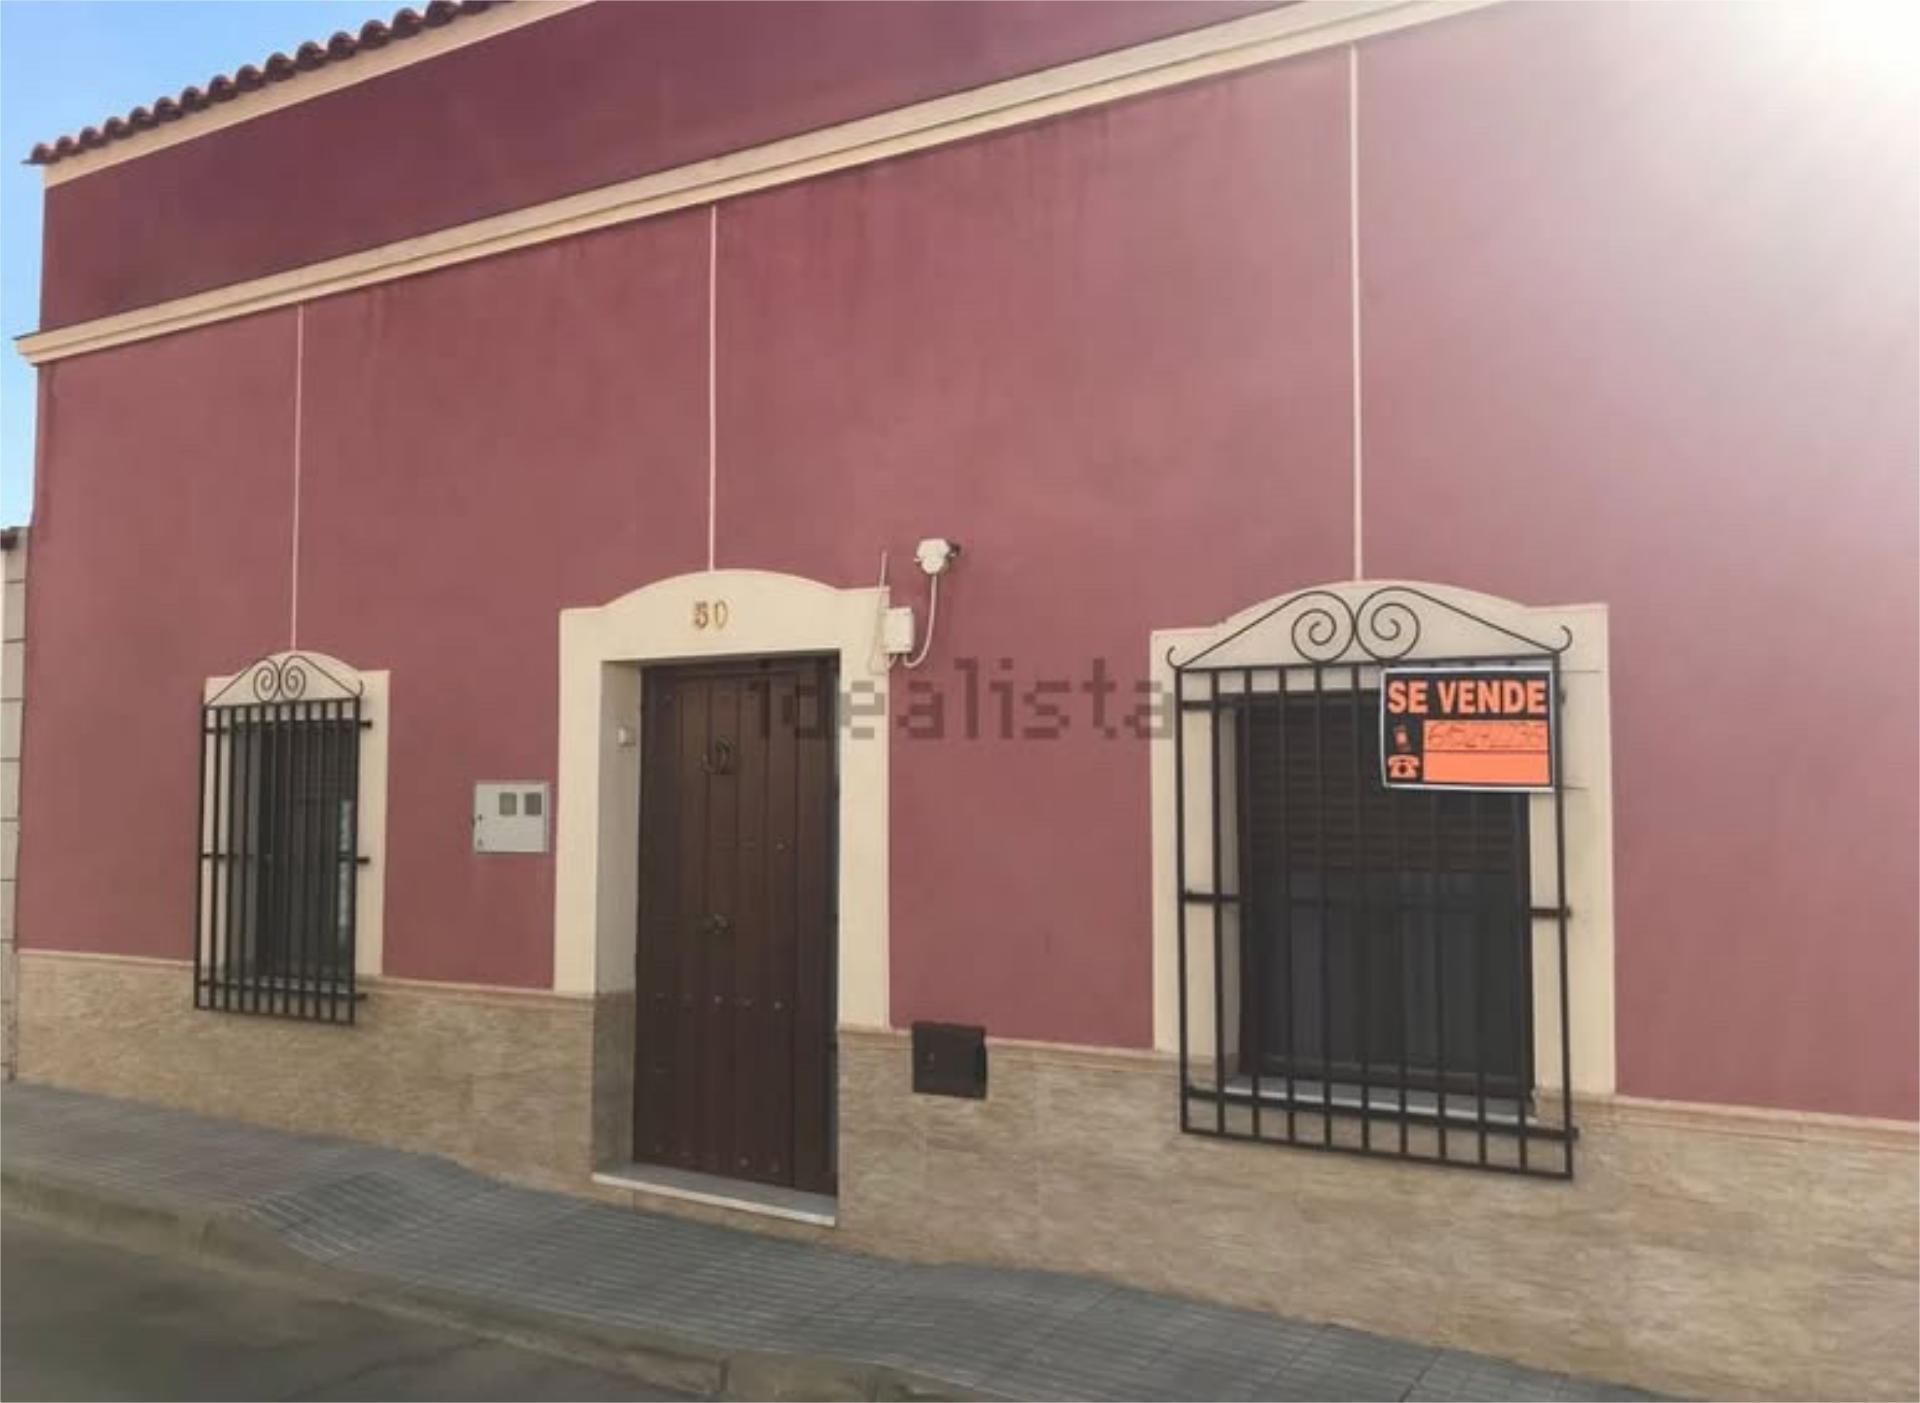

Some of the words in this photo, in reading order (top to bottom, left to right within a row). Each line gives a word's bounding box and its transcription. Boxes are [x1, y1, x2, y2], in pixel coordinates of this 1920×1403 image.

[694, 599, 729, 630] 50
[1387, 679, 1429, 715] SE
[1437, 679, 1548, 715] VENDE
